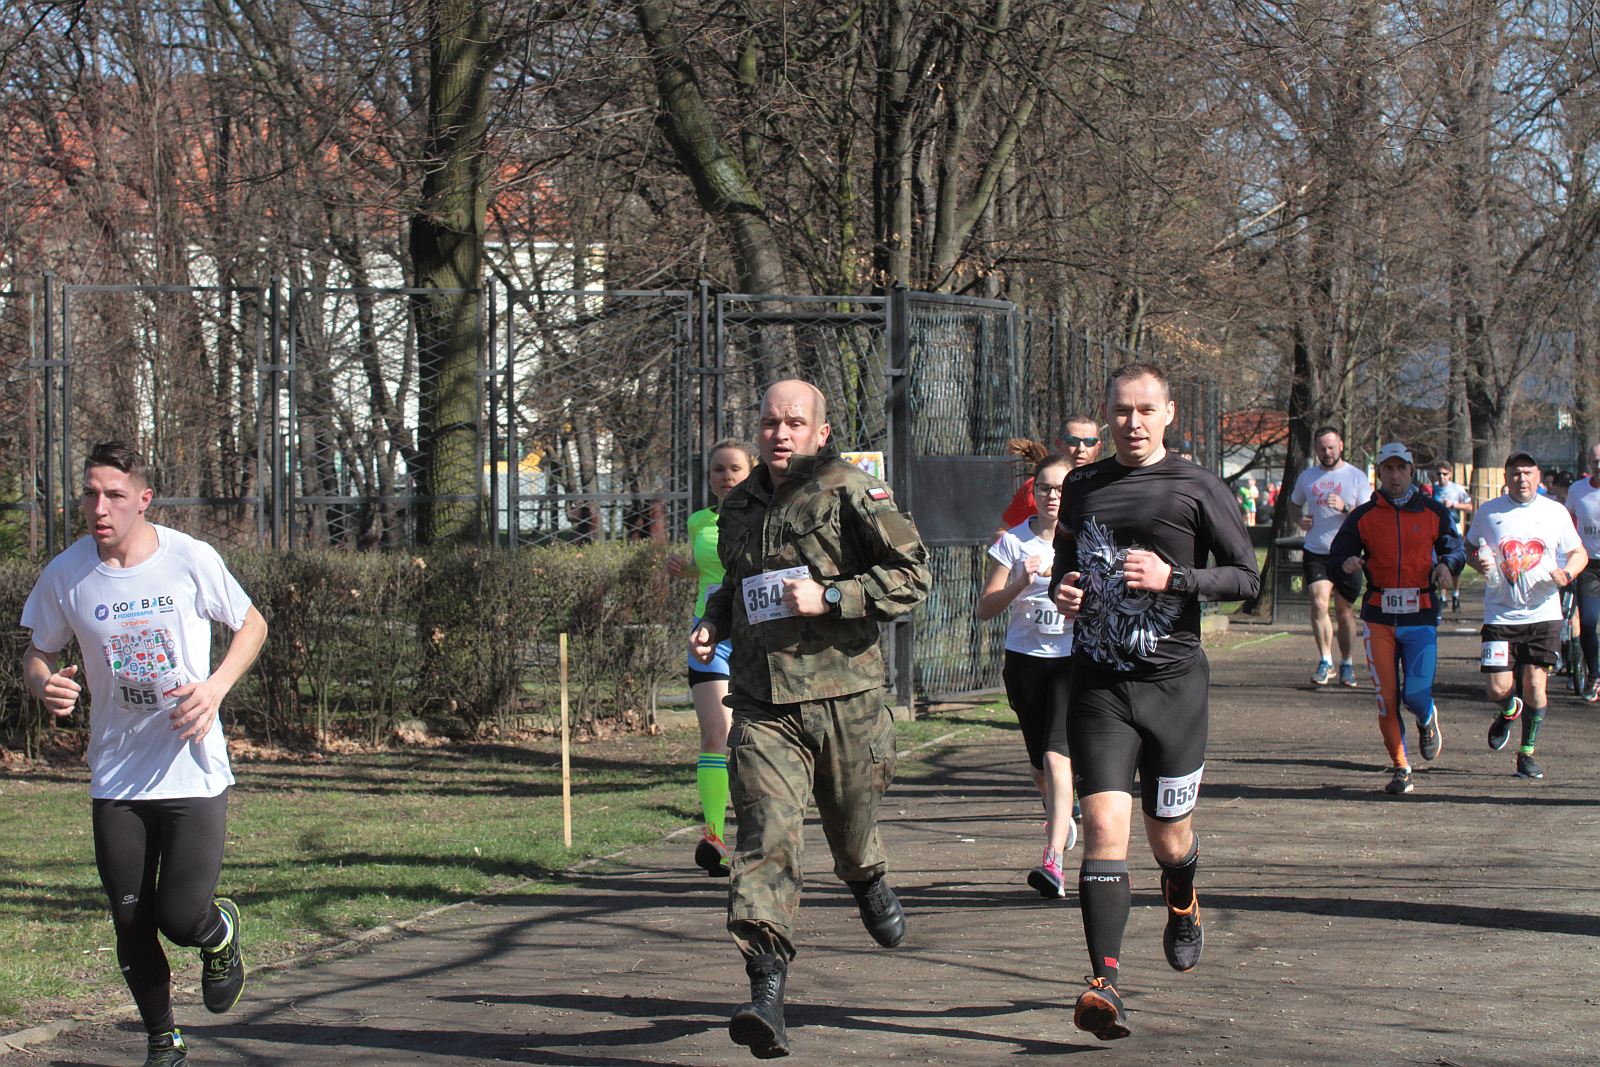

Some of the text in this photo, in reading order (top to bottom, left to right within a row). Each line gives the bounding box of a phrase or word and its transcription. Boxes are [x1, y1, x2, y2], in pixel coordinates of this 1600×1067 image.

[747, 584, 782, 612] 354
[1386, 594, 1403, 607] 161
[1034, 608, 1060, 626] 207
[120, 686, 158, 705] 155
[1163, 782, 1196, 807] 053
